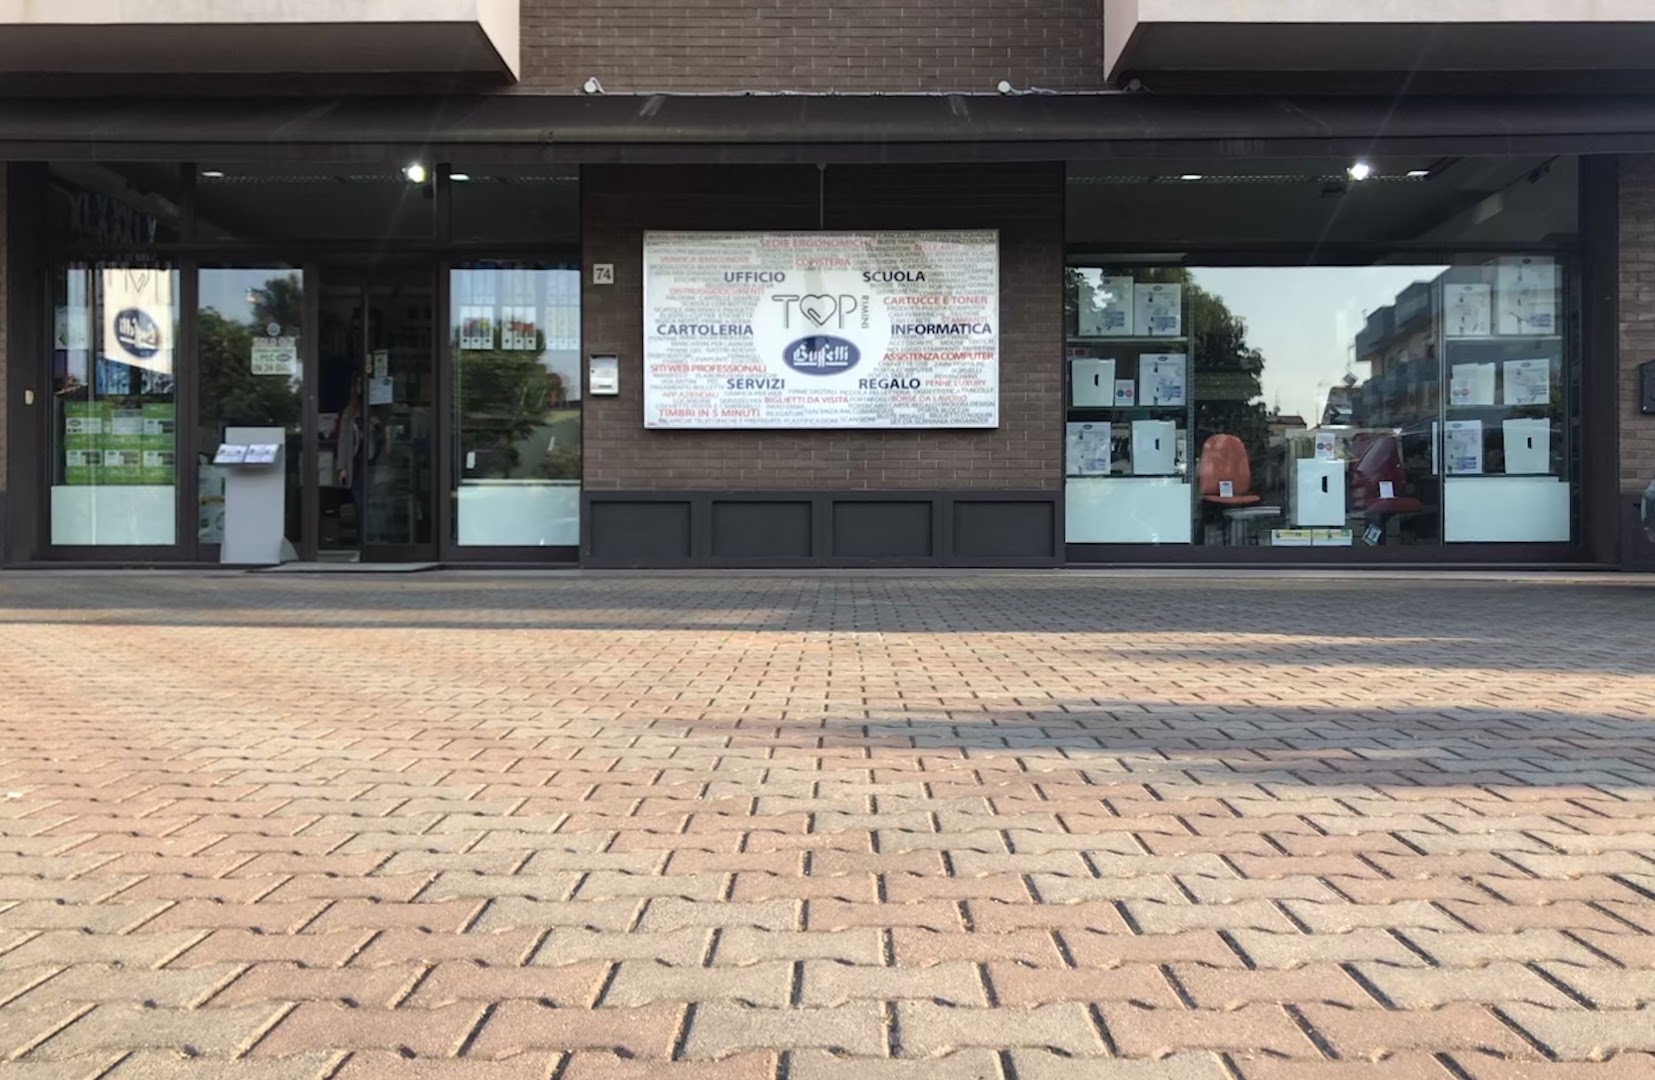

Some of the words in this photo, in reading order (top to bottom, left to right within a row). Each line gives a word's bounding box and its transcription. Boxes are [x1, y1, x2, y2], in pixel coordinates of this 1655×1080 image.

[760, 239, 790, 248] SEDIE
[793, 239, 874, 248] ERGONOMICHE
[796, 258, 851, 266] COPISTERIA
[596, 268, 611, 280] 74
[724, 271, 785, 282] UFFICIO
[863, 271, 925, 282] SCUOLA
[883, 296, 940, 304] CARTUCCE
[943, 296, 949, 304] E
[953, 296, 987, 304] TONER
[861, 295, 869, 328] RIMINI
[657, 324, 753, 335] CARTOLERIA
[891, 323, 991, 334] INFORMATICA
[884, 352, 939, 360] ASSISTENZA
[941, 352, 993, 360] COMPUTER
[650, 364, 667, 372] SITI
[669, 364, 689, 372] WEB
[691, 364, 766, 372] PROFESSIONALI
[727, 379, 785, 389] SERVIZI
[859, 379, 921, 389] REGALO
[659, 409, 695, 417] TIMBRI
[699, 409, 709, 417] IN
[713, 409, 718, 417] 5
[721, 409, 760, 417] MINUTI
